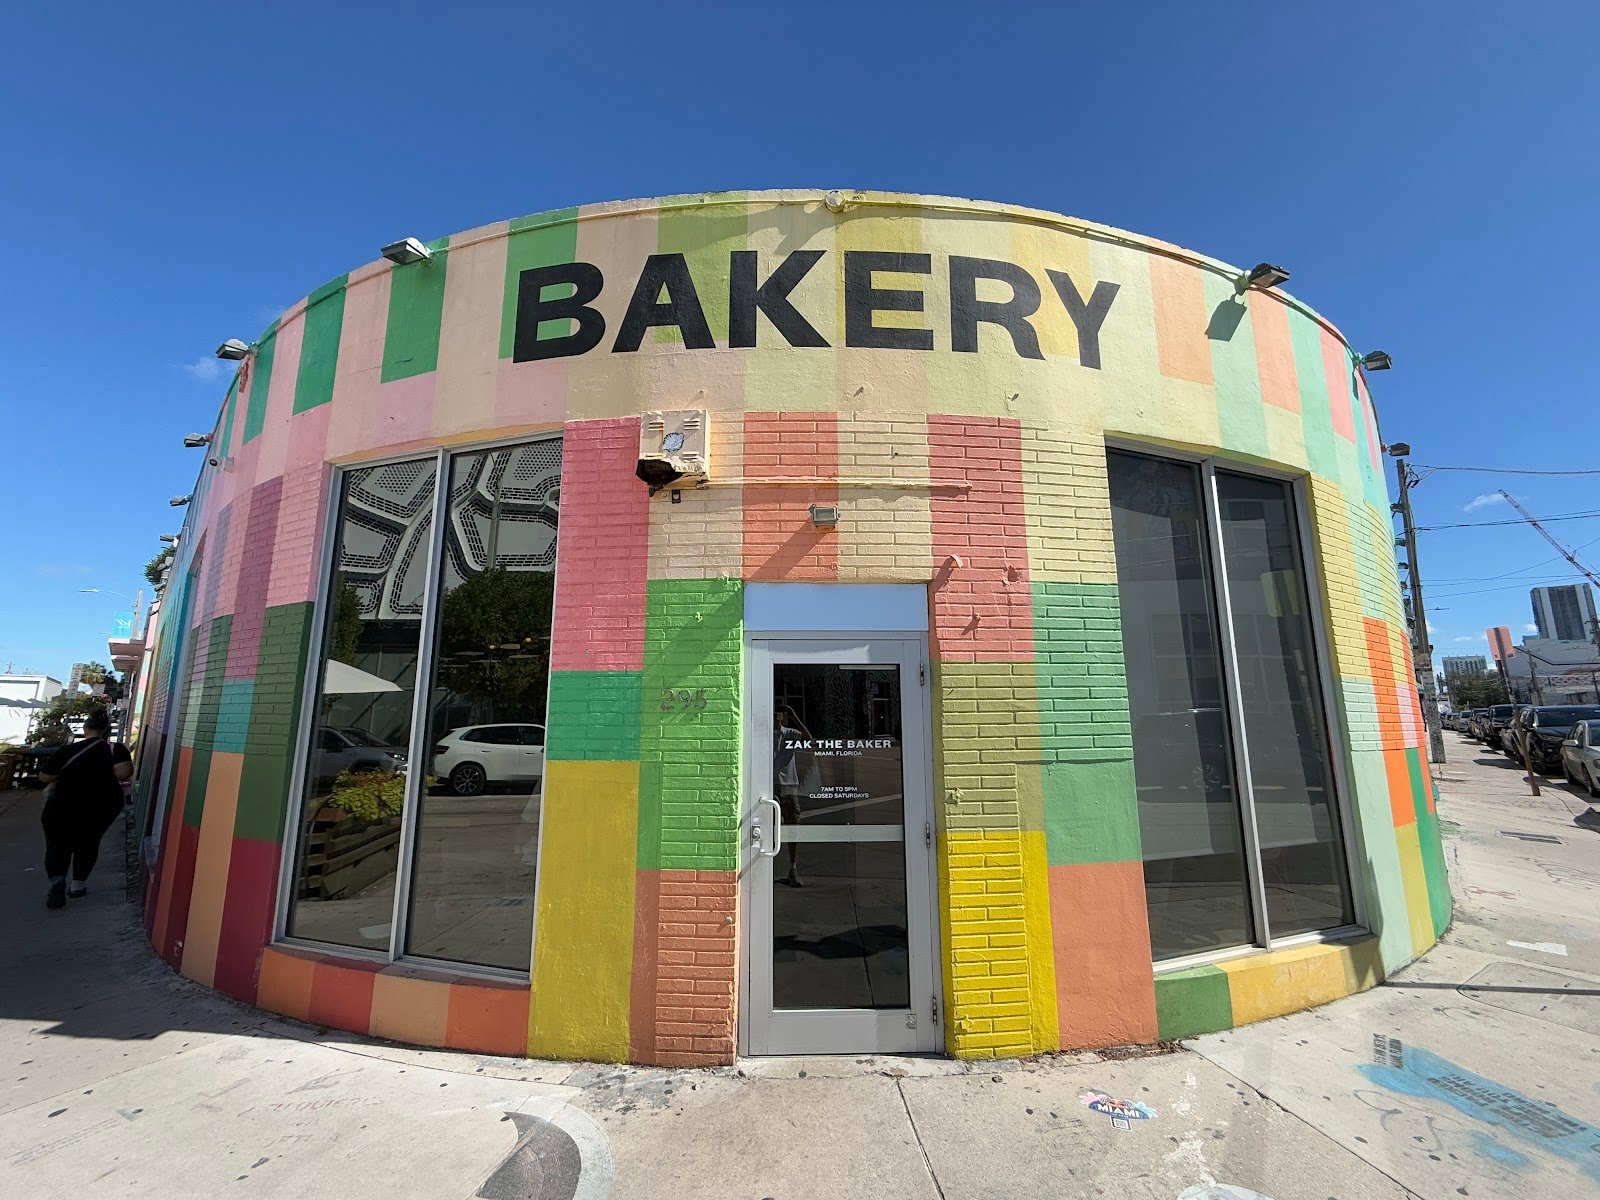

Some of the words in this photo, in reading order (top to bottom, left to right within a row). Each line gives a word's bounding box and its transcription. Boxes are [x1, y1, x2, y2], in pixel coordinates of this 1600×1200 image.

[513, 249, 1121, 370] BAKERY
[661, 688, 708, 712] 295
[785, 740, 812, 749] ZAK
[816, 740, 842, 749] THE
[847, 739, 892, 749] BAKER
[1097, 1103, 1140, 1118] MIAMI
